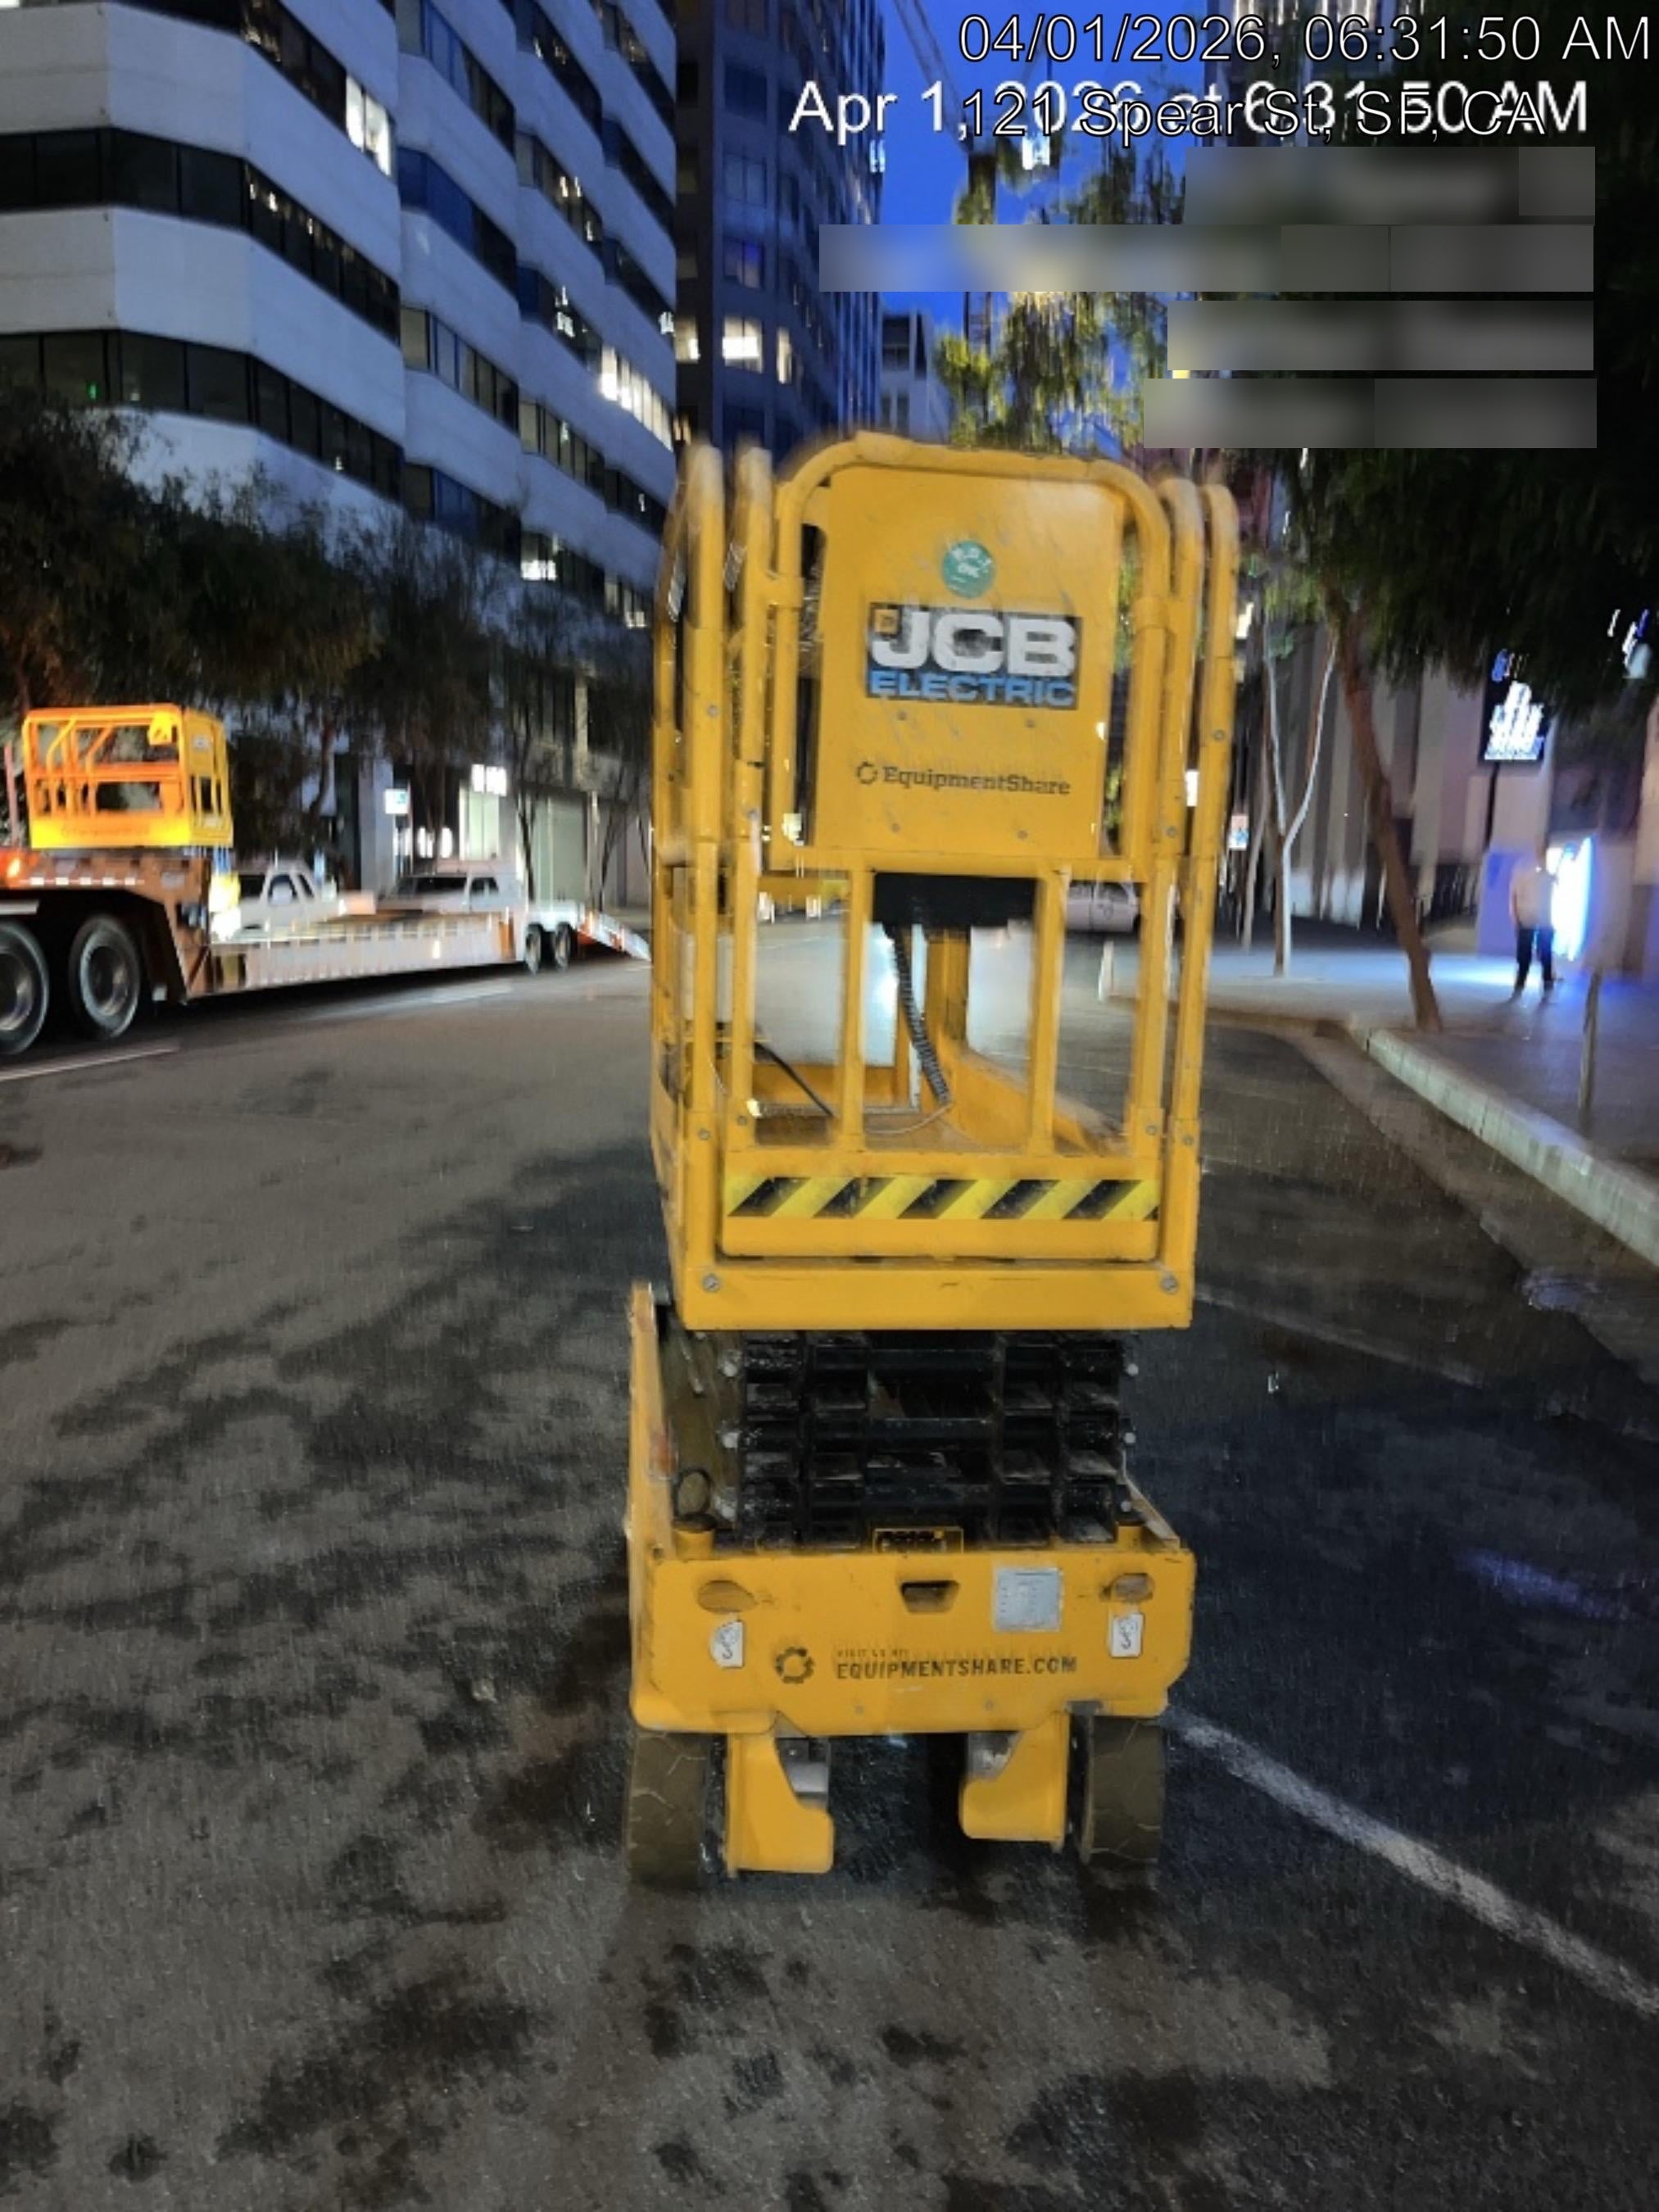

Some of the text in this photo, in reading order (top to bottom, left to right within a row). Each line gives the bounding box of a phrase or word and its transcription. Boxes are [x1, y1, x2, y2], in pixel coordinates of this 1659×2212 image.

[870, 608, 1077, 678] JCB
[869, 669, 1075, 707] ELECTRIC
[882, 765, 1072, 796] EquipmentShare
[836, 1657, 1078, 1679] EQUIPMENTSHARE.COM
